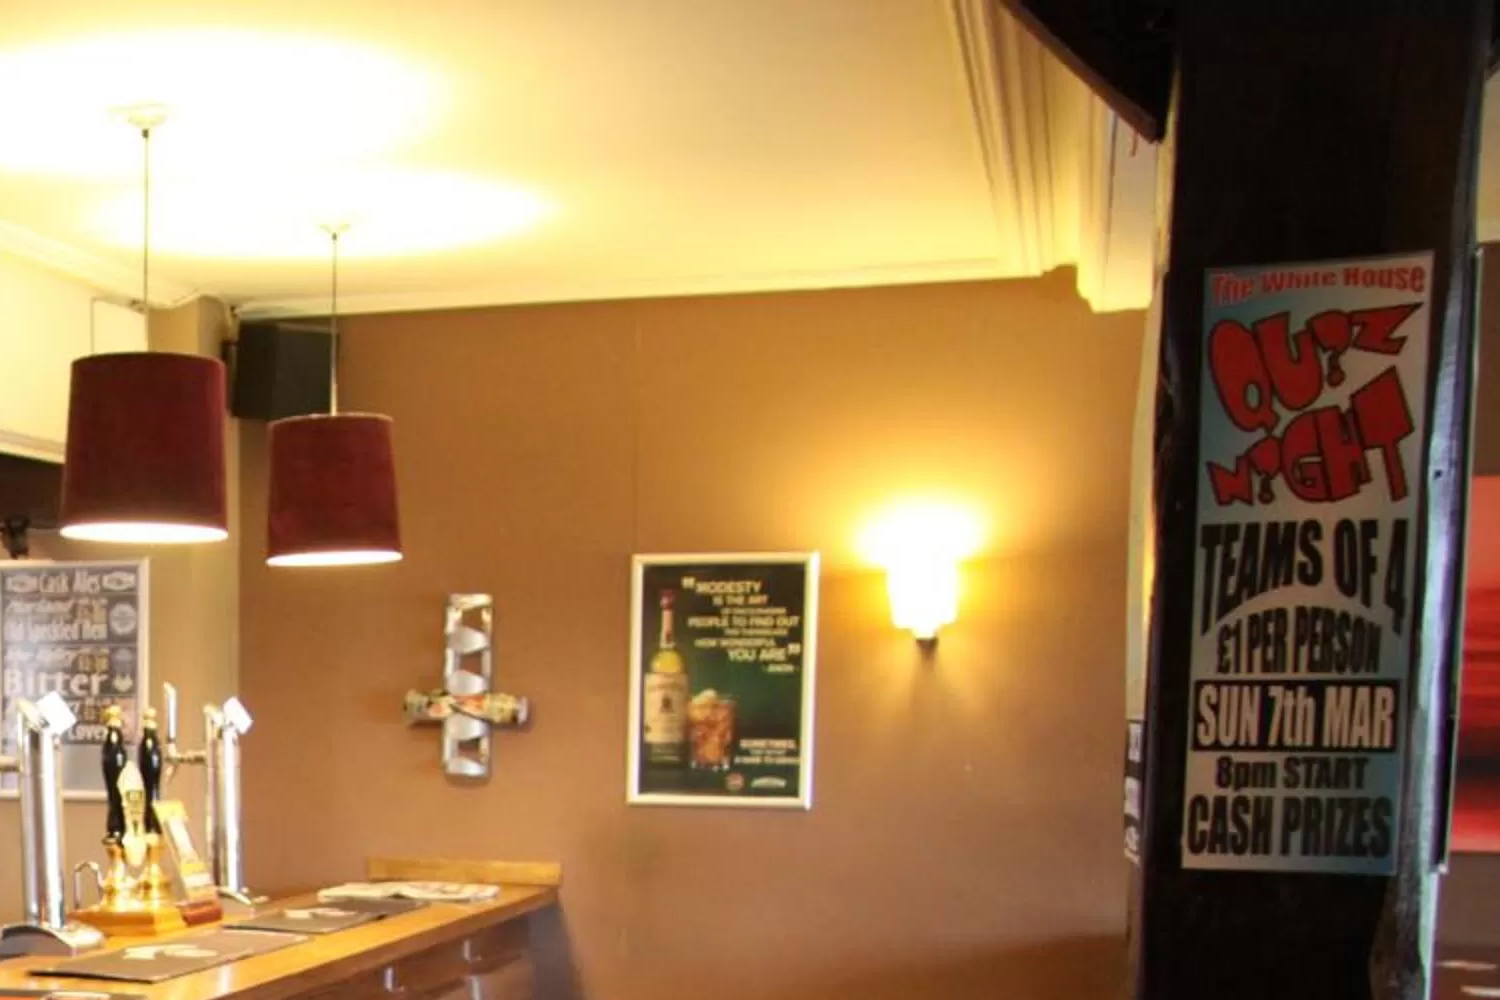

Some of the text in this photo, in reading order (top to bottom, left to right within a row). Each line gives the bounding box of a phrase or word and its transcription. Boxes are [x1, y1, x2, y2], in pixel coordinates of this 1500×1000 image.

[1343, 265, 1426, 293] House
[1199, 518, 1409, 637] TEAMS OF 4
[1216, 605, 1381, 675] £1 PER PERSON
[1197, 684, 1395, 748] SUN 7th MAR
[1215, 756, 1370, 791] 8pm START
[1187, 794, 1392, 858] CASH PRIZES
